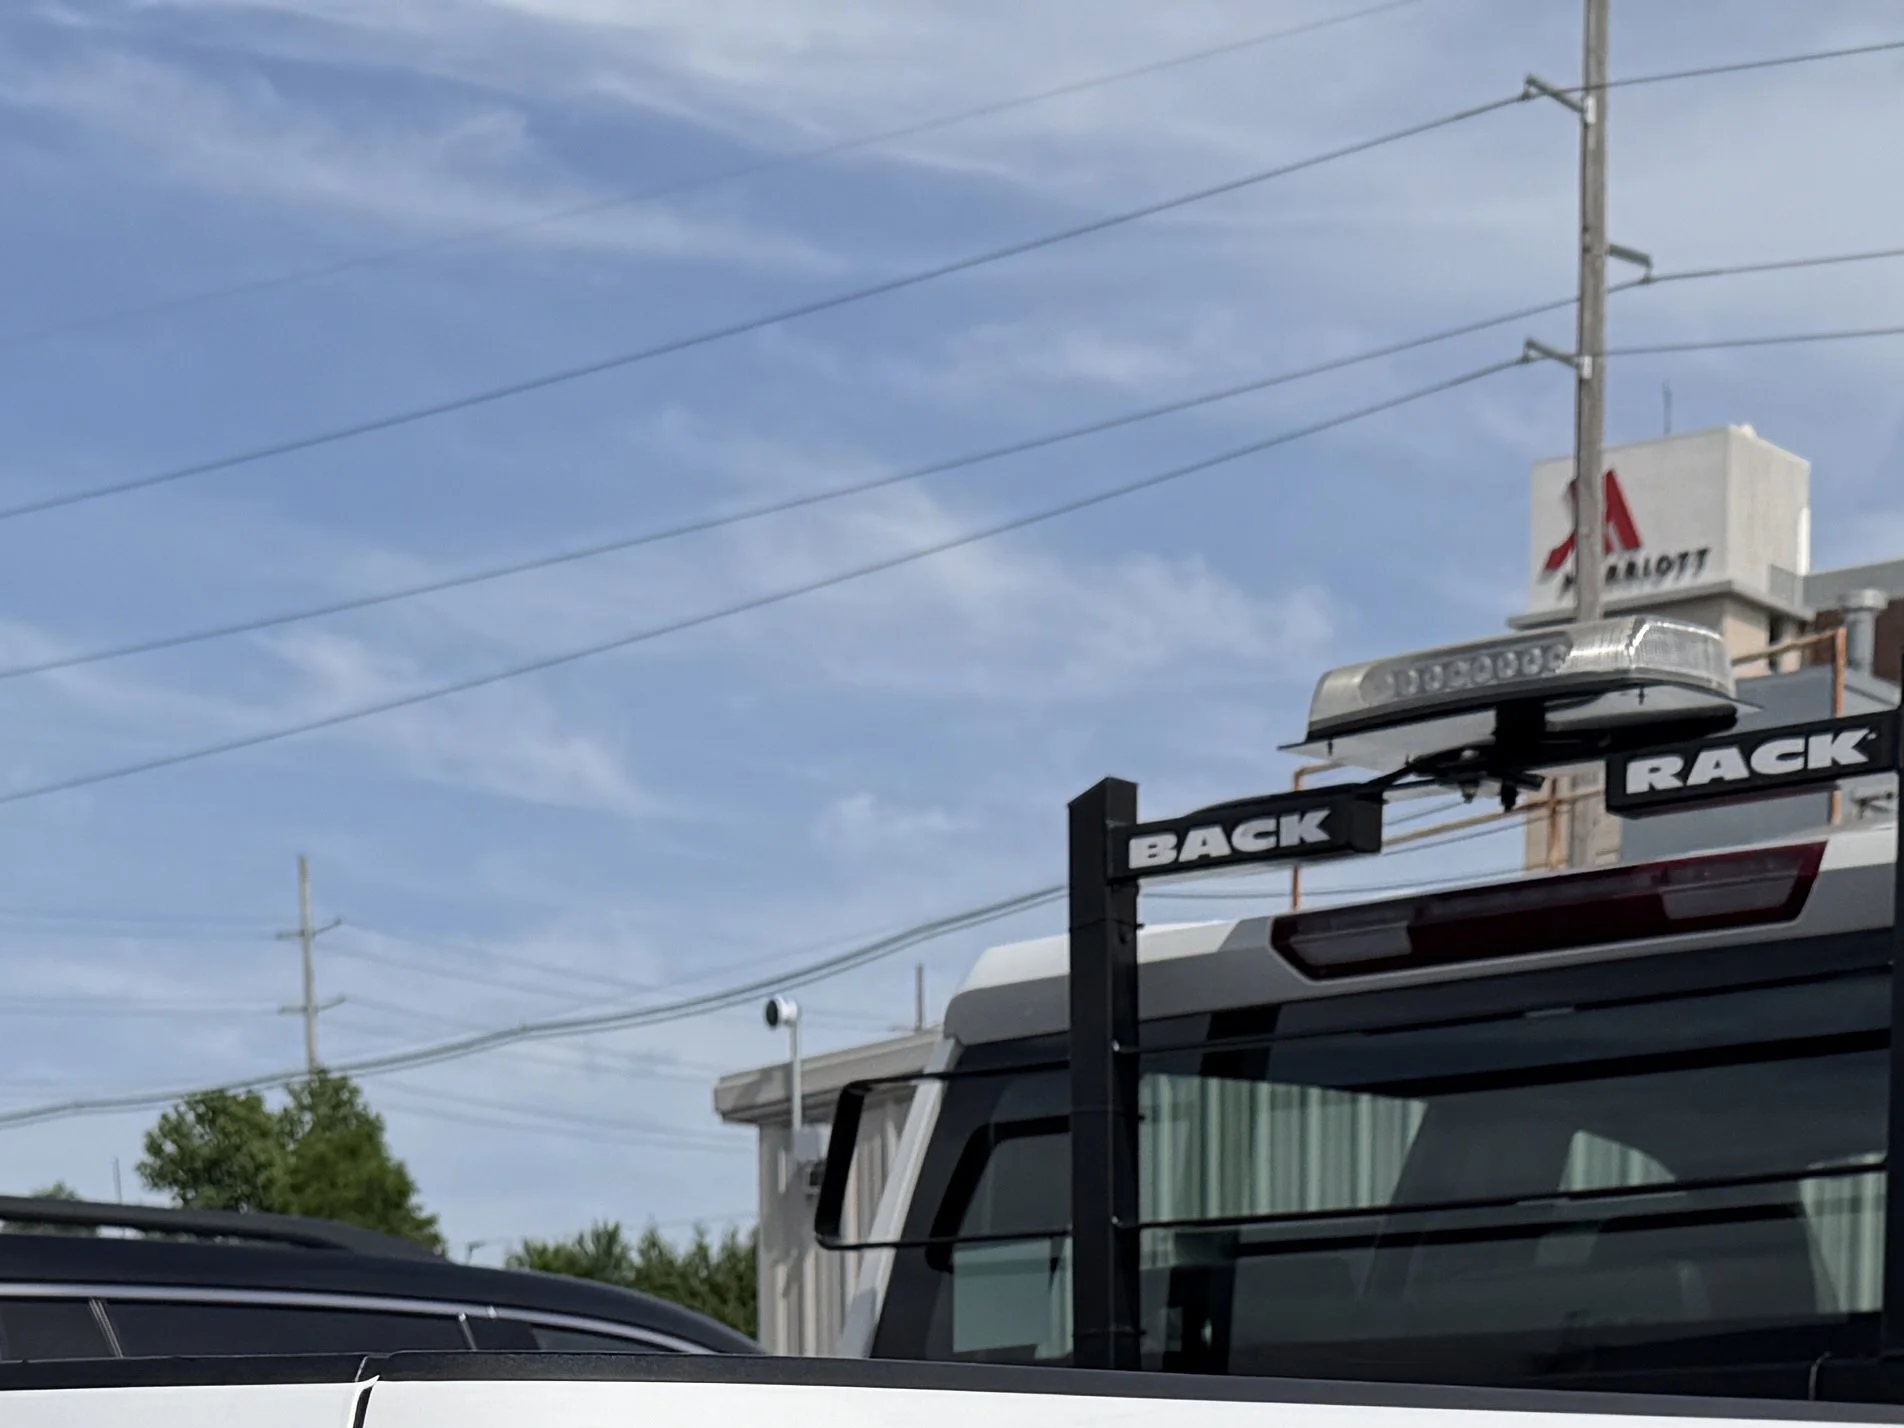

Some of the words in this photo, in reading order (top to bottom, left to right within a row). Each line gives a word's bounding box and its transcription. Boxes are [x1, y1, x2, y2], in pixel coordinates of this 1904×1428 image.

[1559, 548, 1711, 591] MRRIOTT
[1626, 728, 1869, 794] RACK
[1128, 808, 1332, 869] BACK
